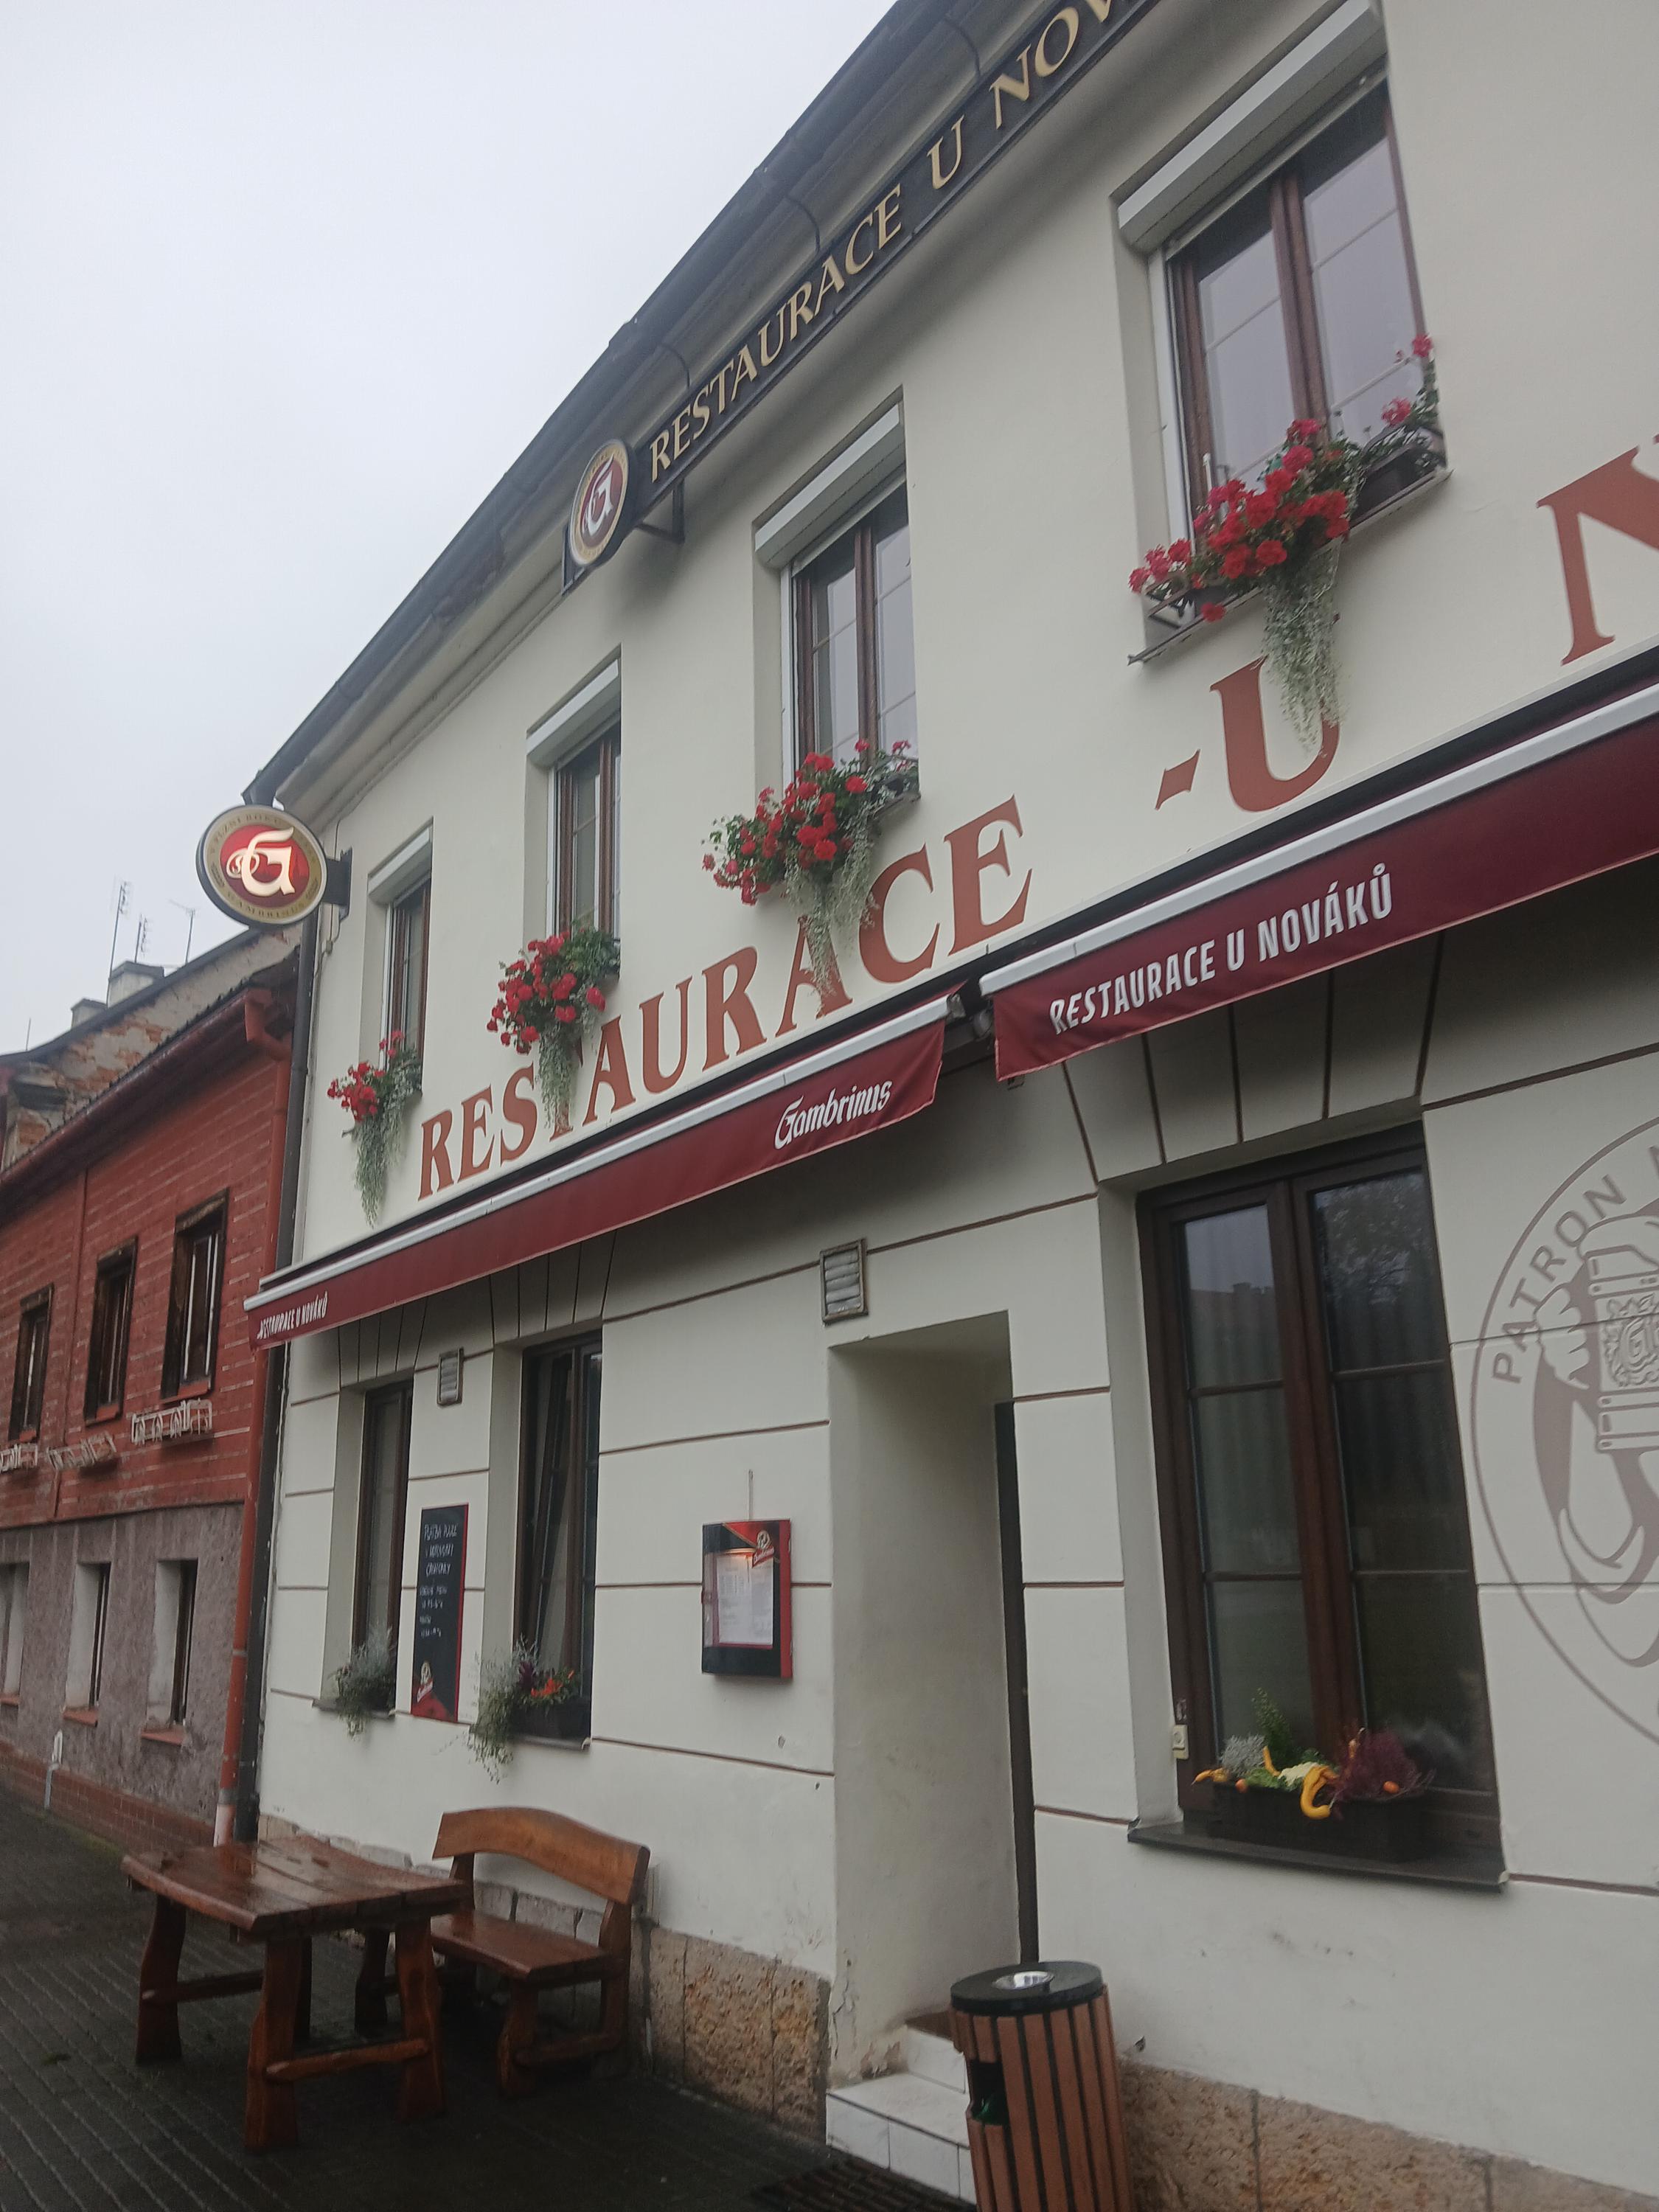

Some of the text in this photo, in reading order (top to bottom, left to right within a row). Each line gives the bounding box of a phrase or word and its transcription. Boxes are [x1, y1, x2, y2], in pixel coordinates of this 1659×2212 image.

[649, 185, 902, 482] RESTAURACE
[928, 116, 964, 190] U
[417, 795, 1033, 1202] RESAURACE
[1048, 863, 1393, 1035] RESTAURACE U NOVÁKŮ
[774, 1080, 893, 1150] Gambrinus
[1492, 1174, 1627, 1385] PATRON
